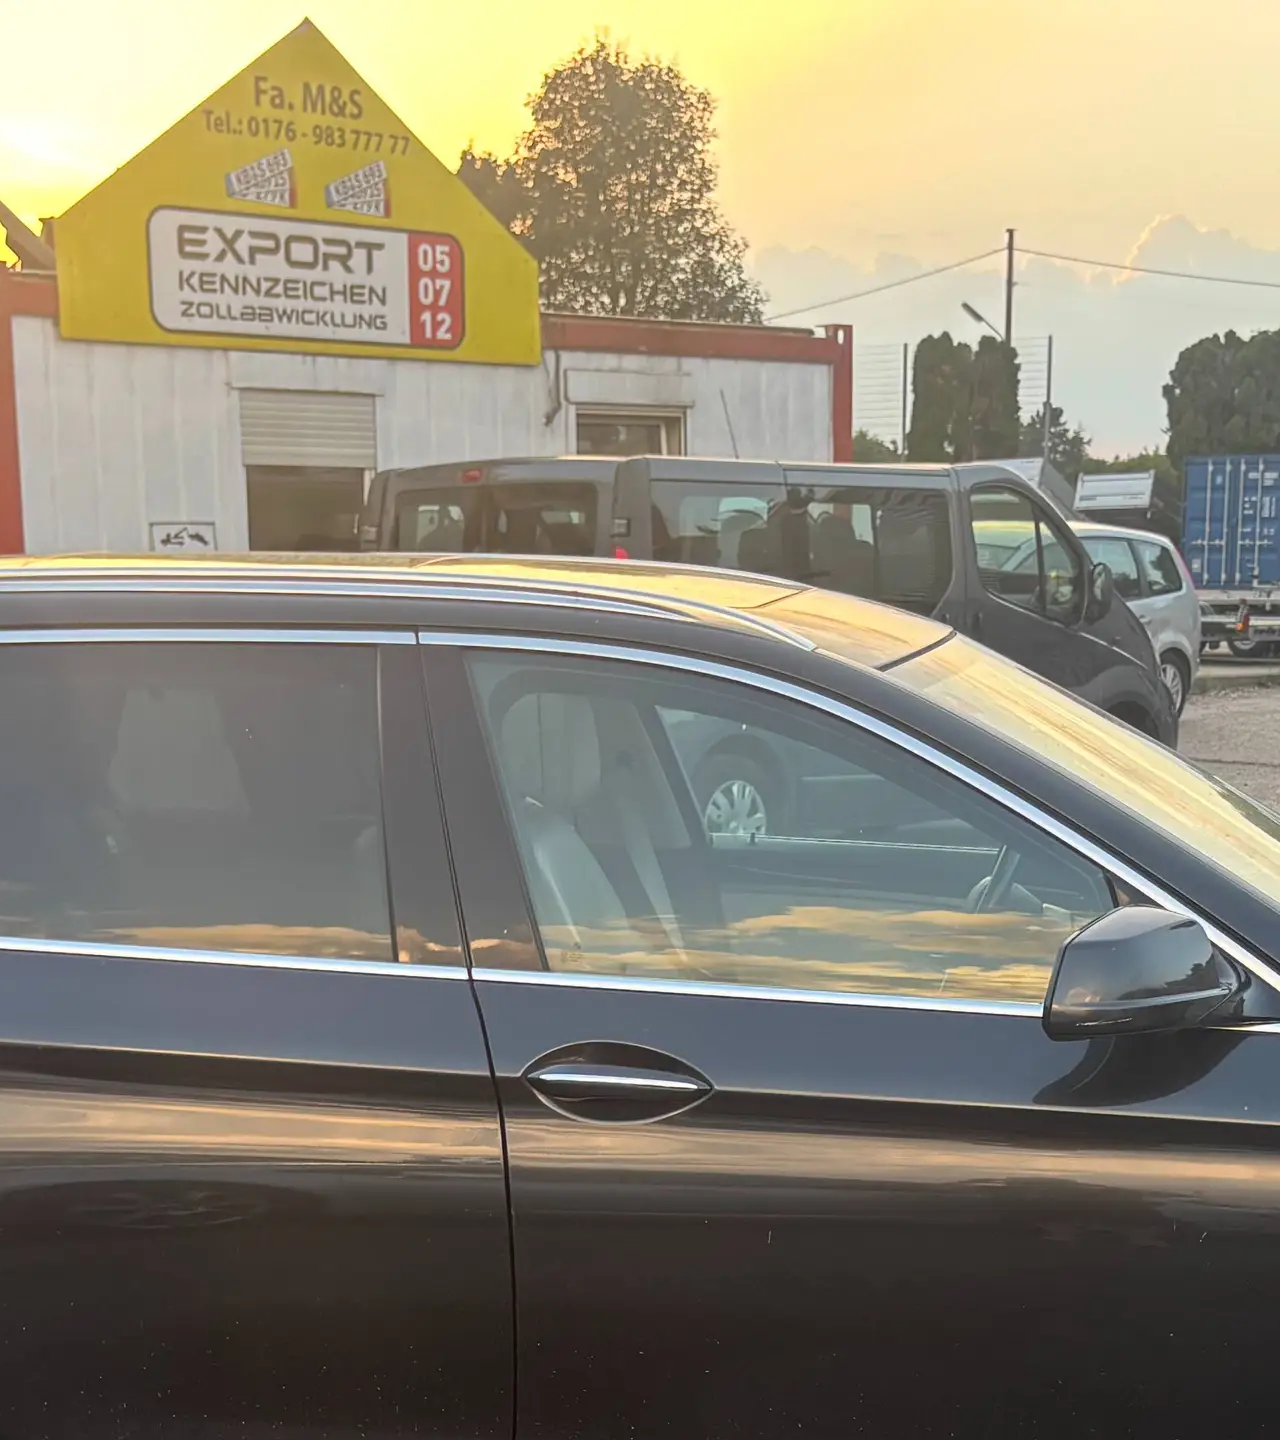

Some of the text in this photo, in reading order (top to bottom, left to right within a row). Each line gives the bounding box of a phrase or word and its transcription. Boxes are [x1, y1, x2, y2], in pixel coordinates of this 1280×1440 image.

[254, 76, 364, 120] Fa. M&S
[202, 109, 242, 136] Tel.:
[247, 116, 297, 142] 0176
[312, 125, 346, 148] 983
[350, 129, 384, 152] 777
[388, 134, 410, 156] 77
[176, 224, 385, 275] EXPORT
[417, 243, 450, 272] 05
[178, 271, 387, 306] KENNZEICHEN
[418, 278, 450, 307] 07
[420, 312, 452, 340] 12
